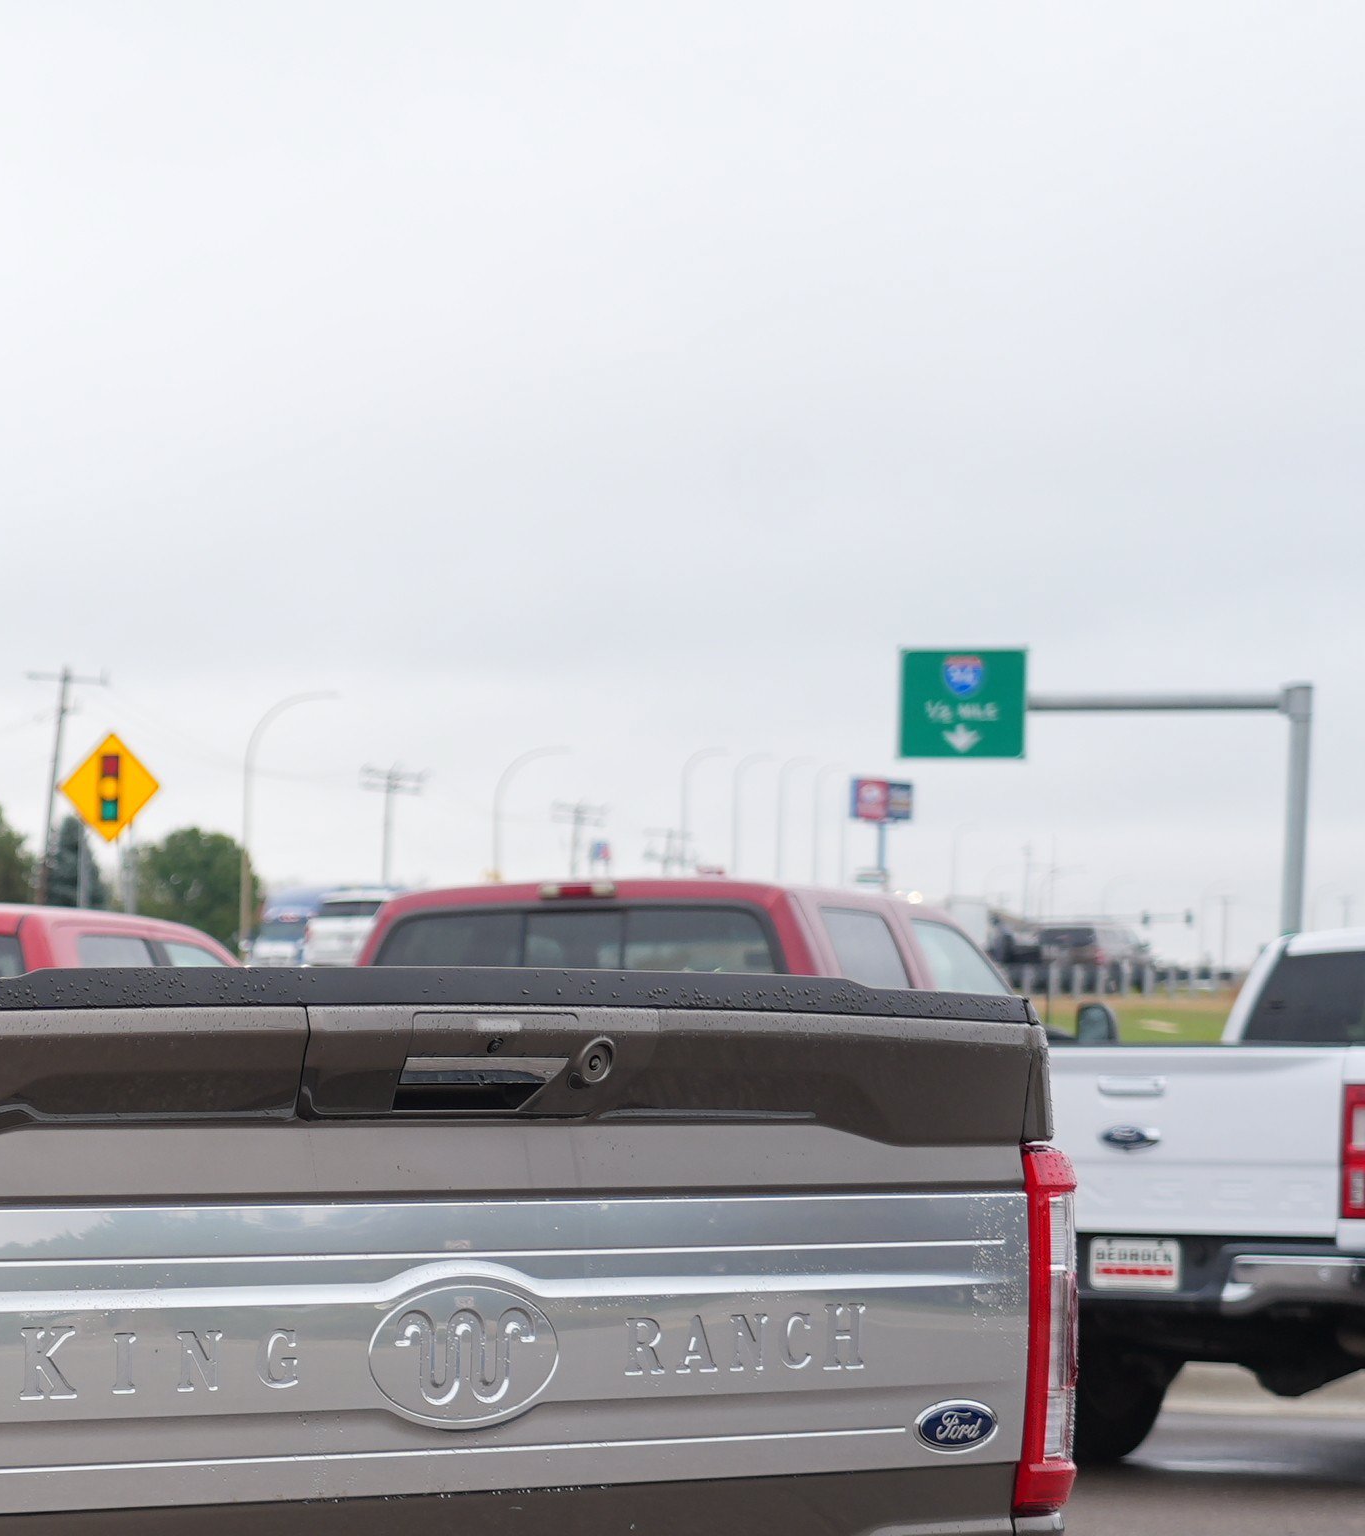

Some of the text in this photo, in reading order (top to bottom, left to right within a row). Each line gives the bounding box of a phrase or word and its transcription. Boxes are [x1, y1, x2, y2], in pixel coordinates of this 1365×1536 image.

[957, 702, 998, 721] MILE
[1096, 1248, 1172, 1262] BEDROCK
[19, 1302, 868, 1401] KING RANCH
[936, 1411, 982, 1439] Ford
